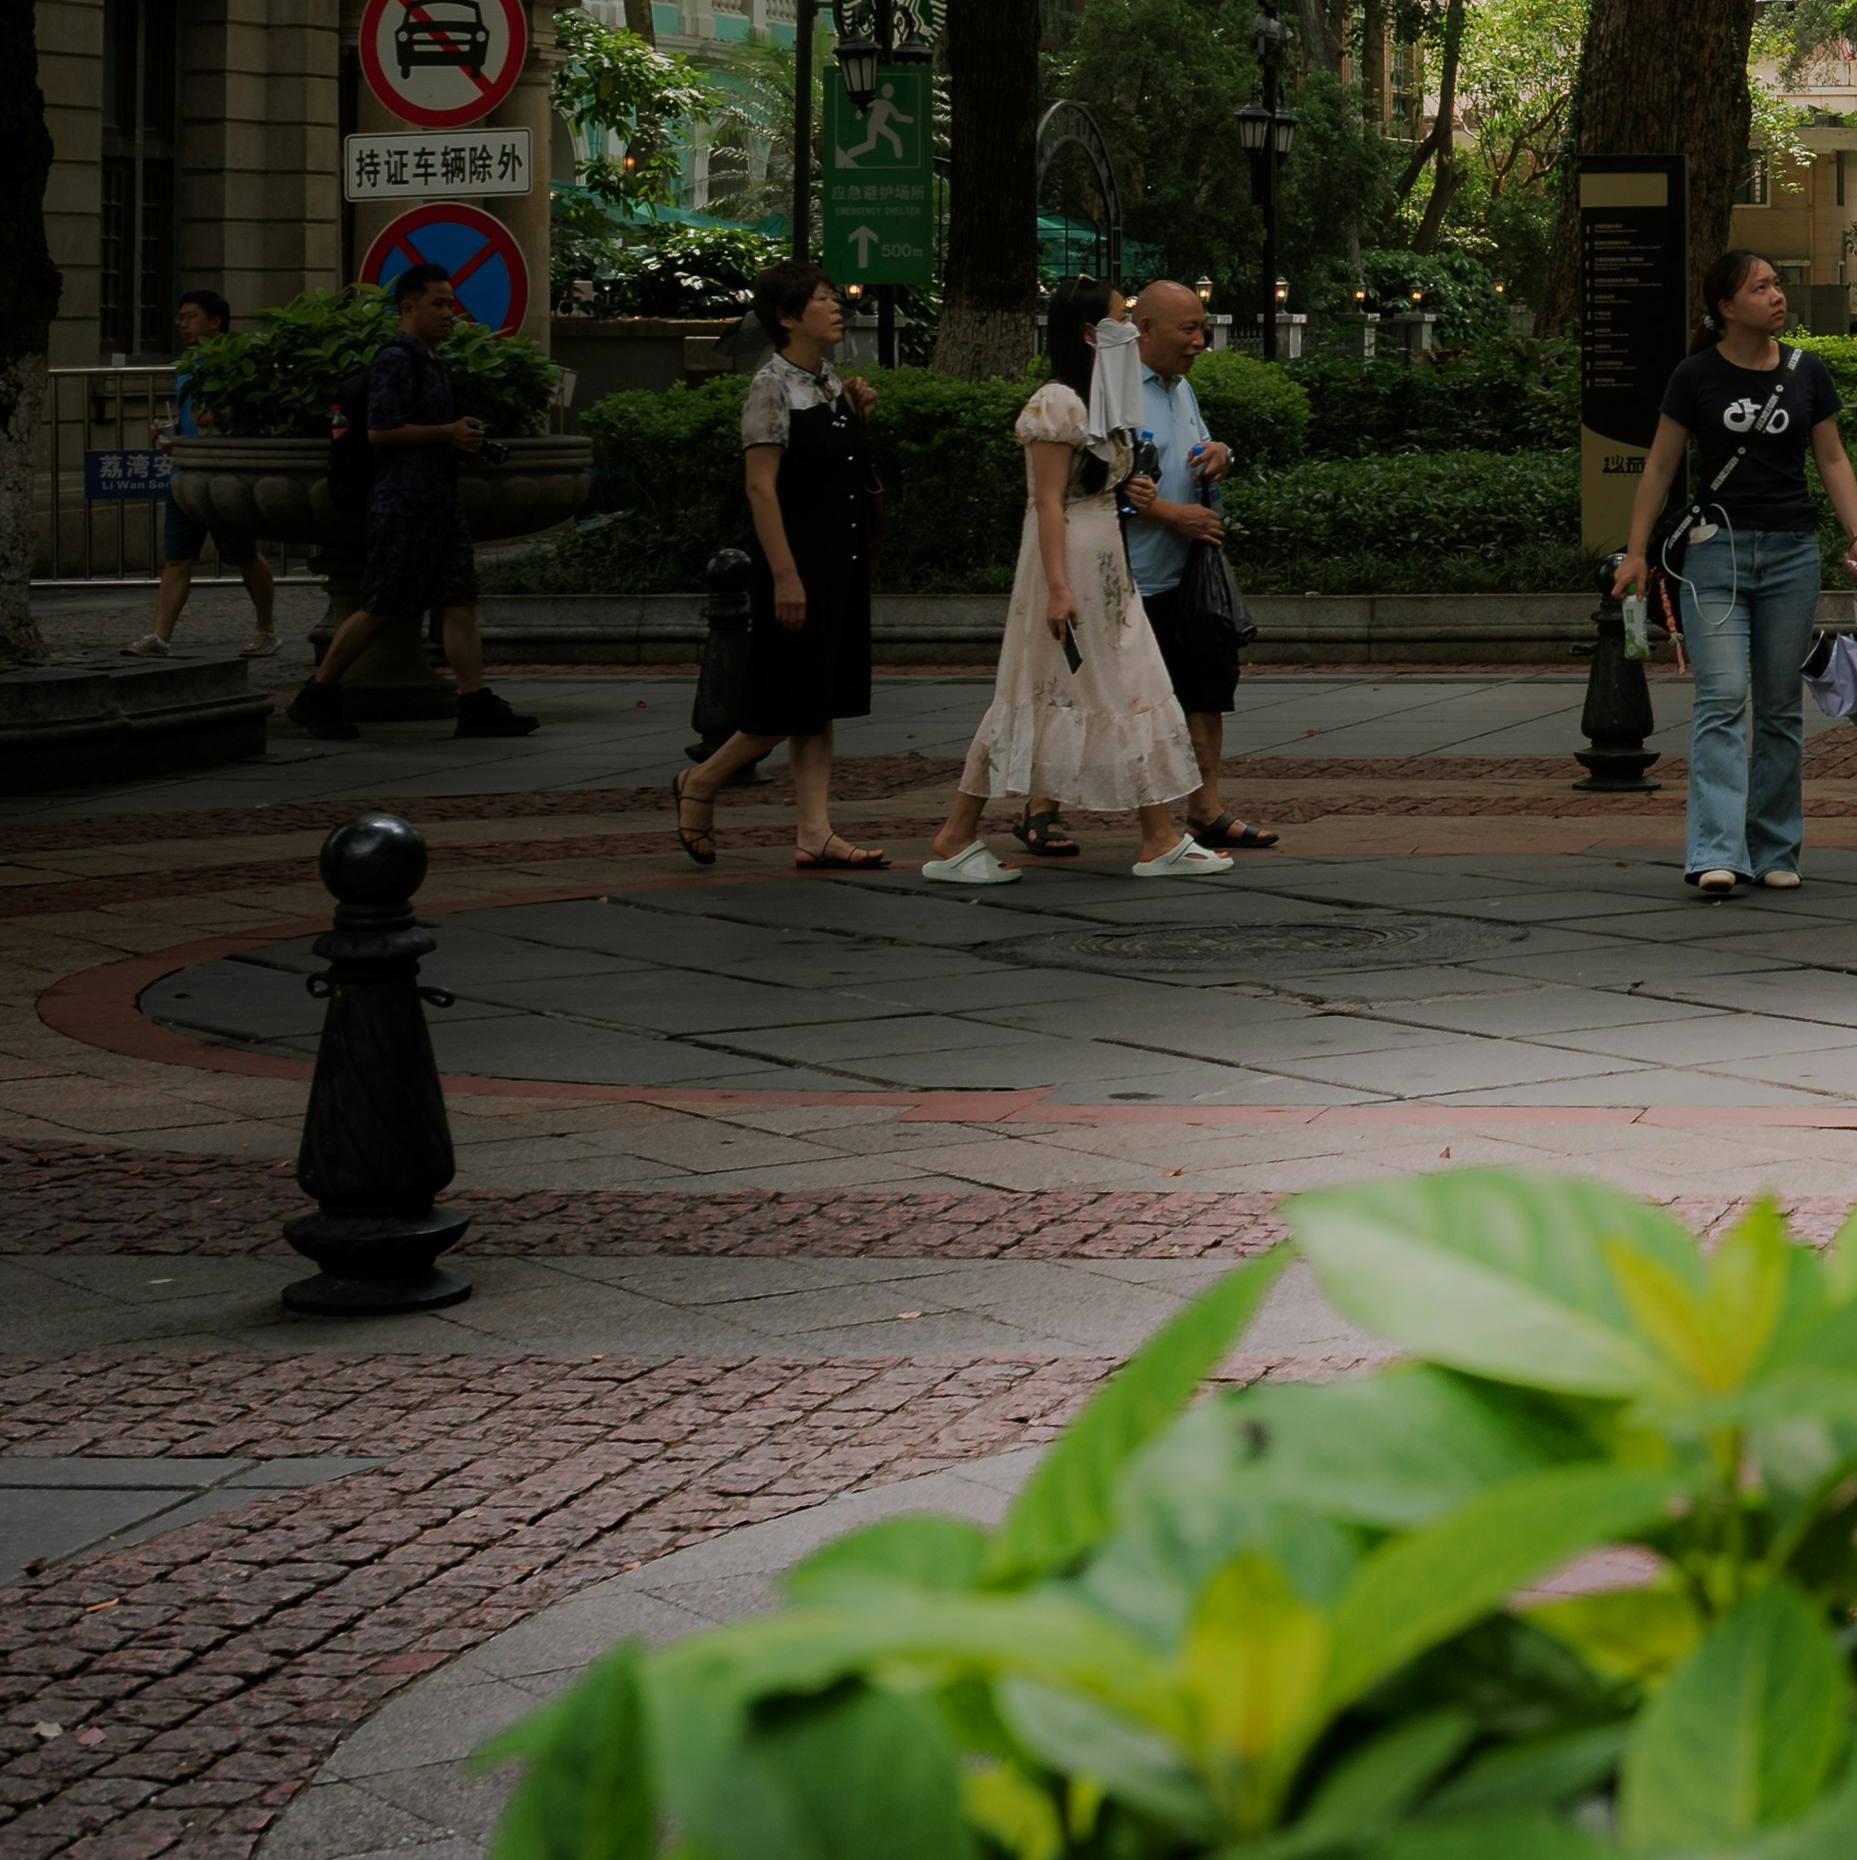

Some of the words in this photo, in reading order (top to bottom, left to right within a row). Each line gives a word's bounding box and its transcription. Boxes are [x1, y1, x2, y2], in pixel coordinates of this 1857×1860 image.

[356, 144, 523, 189] 持证车辆除外
[884, 206, 921, 216] SHELTER
[881, 243, 923, 258] 500m
[102, 480, 114, 490] Li
[116, 480, 145, 490] Wan
